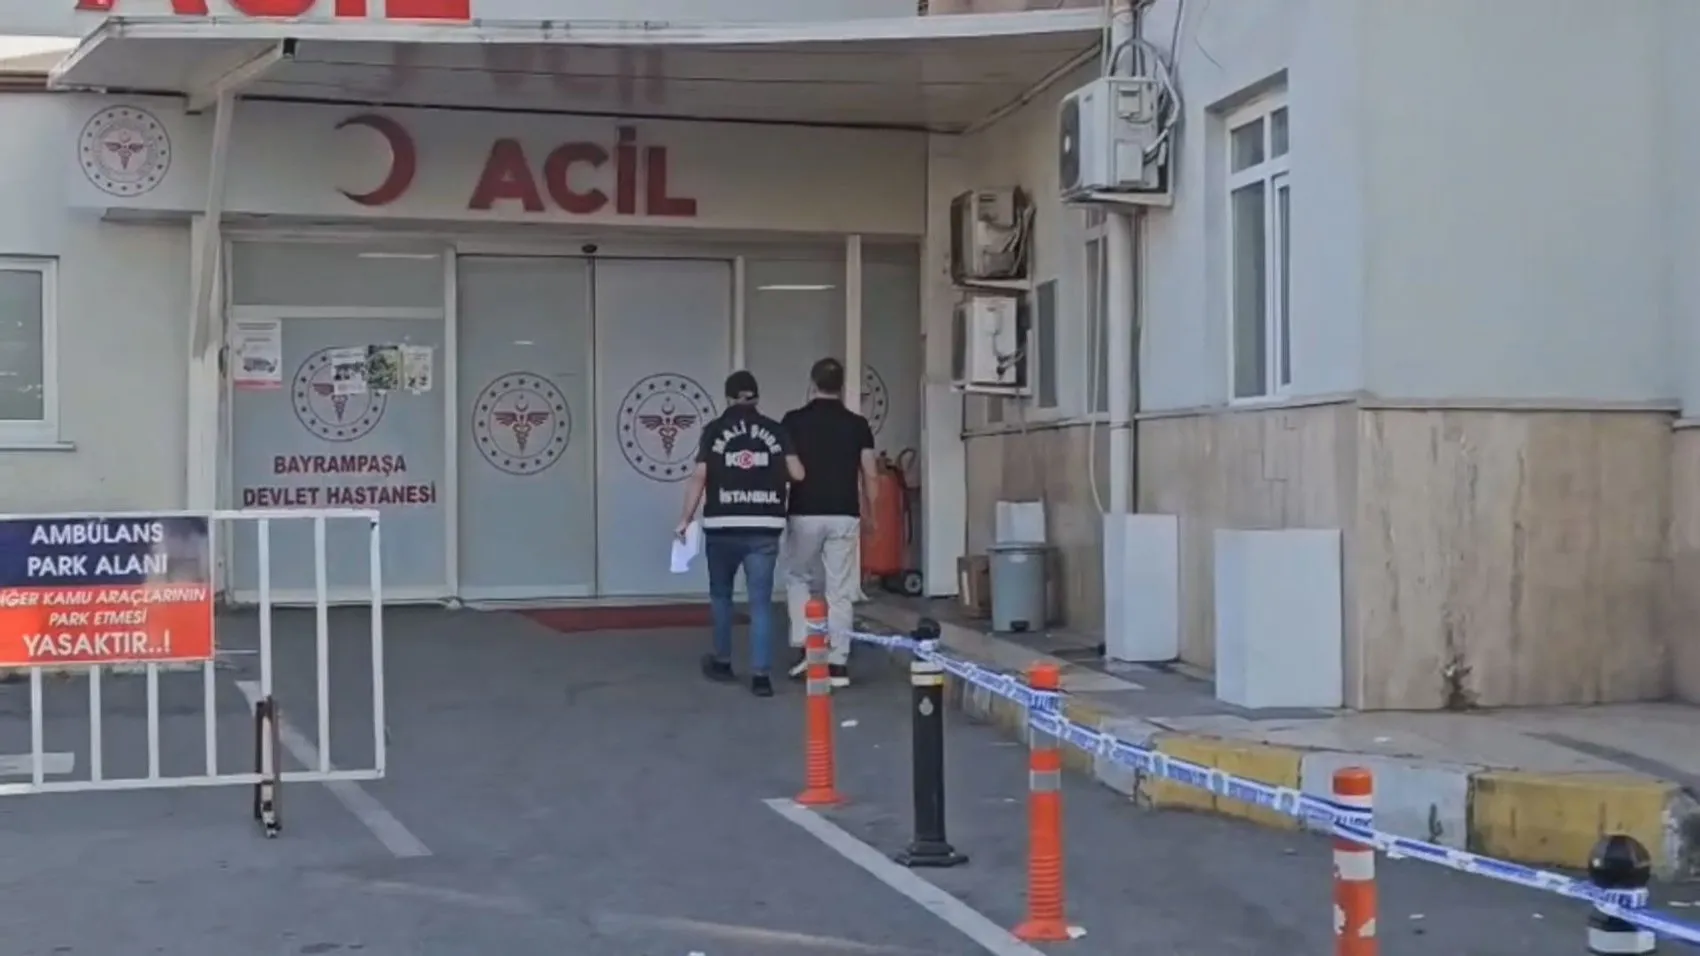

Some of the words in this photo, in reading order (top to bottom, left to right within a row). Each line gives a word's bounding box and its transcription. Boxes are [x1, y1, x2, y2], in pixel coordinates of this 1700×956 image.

[467, 125, 697, 217] ACİL
[712, 419, 747, 455] MALİ
[273, 455, 407, 477] BAYRAMPAŞA
[243, 487, 319, 507] DEVLET
[327, 481, 436, 505] HASTANESİ
[719, 487, 781, 504] İSTANBUL
[30, 521, 164, 545] AMBÜLANS
[27, 555, 88, 577] PARK
[94, 553, 168, 576] ALANI
[43, 590, 91, 605] KAMU
[95, 586, 206, 606] ARAÇLARININ
[48, 611, 90, 626] PARK
[94, 608, 148, 625] ETMESİ
[23, 629, 171, 656] YASAKTIR..!
